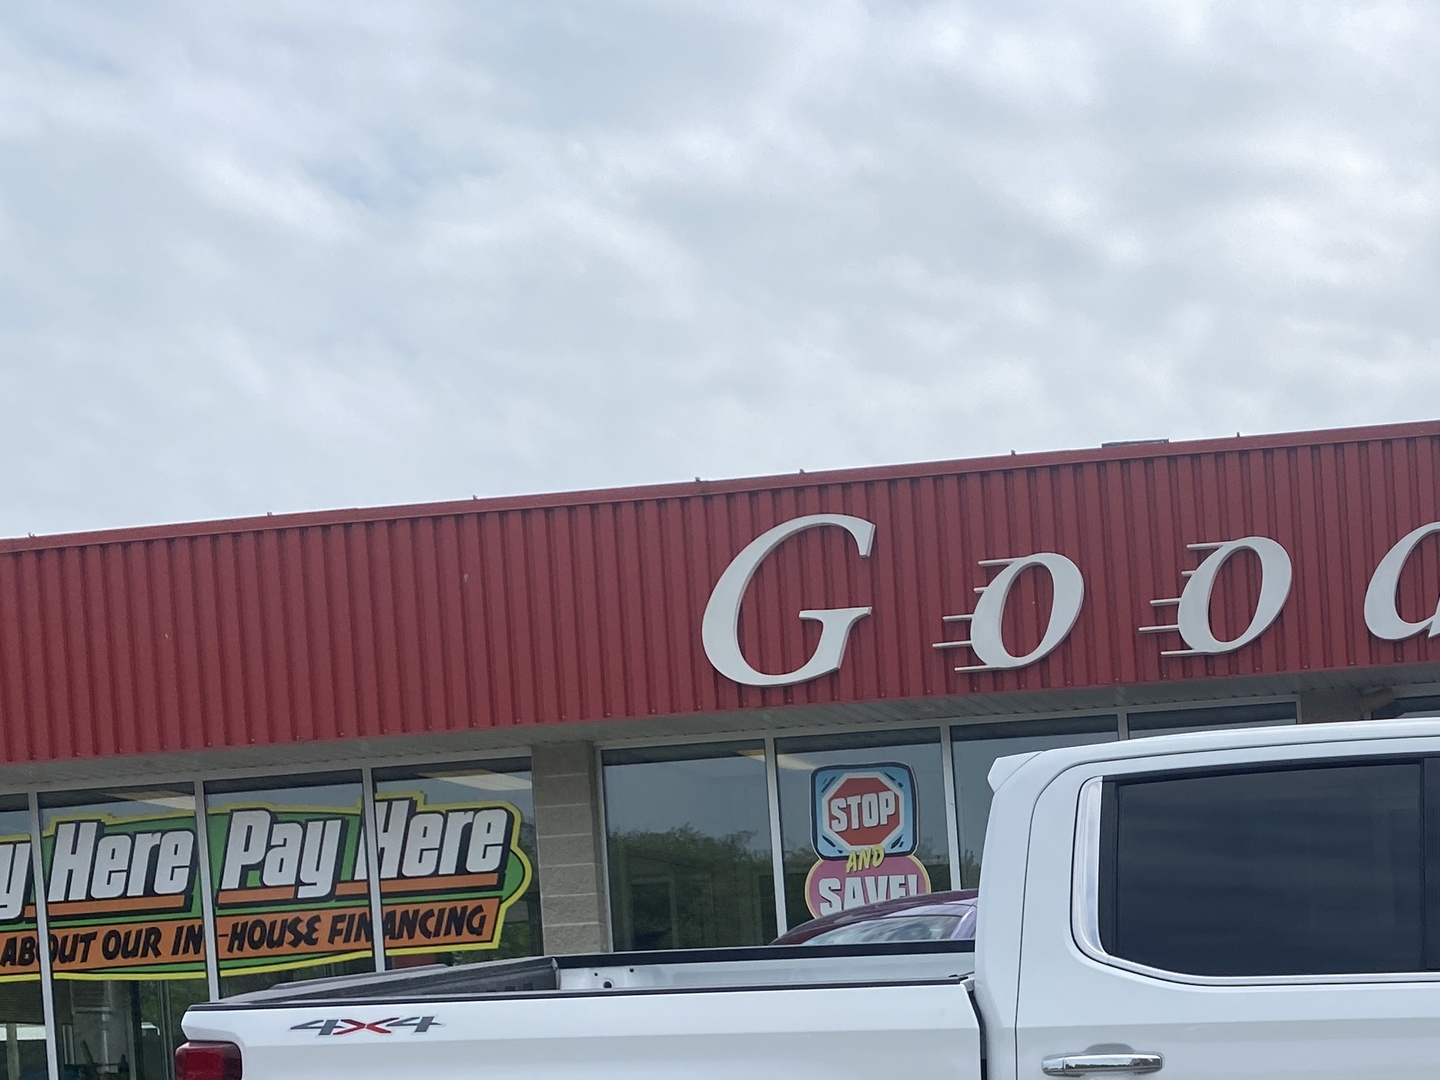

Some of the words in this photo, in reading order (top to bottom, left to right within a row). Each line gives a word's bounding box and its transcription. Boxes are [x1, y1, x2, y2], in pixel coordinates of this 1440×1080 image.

[830, 790, 896, 833] STOP
[47, 821, 195, 902] Here
[221, 809, 343, 899] Pay
[354, 799, 508, 881] Here
[845, 843, 886, 874] AND
[101, 926, 163, 960] OUR
[327, 904, 487, 944] FINANCING
